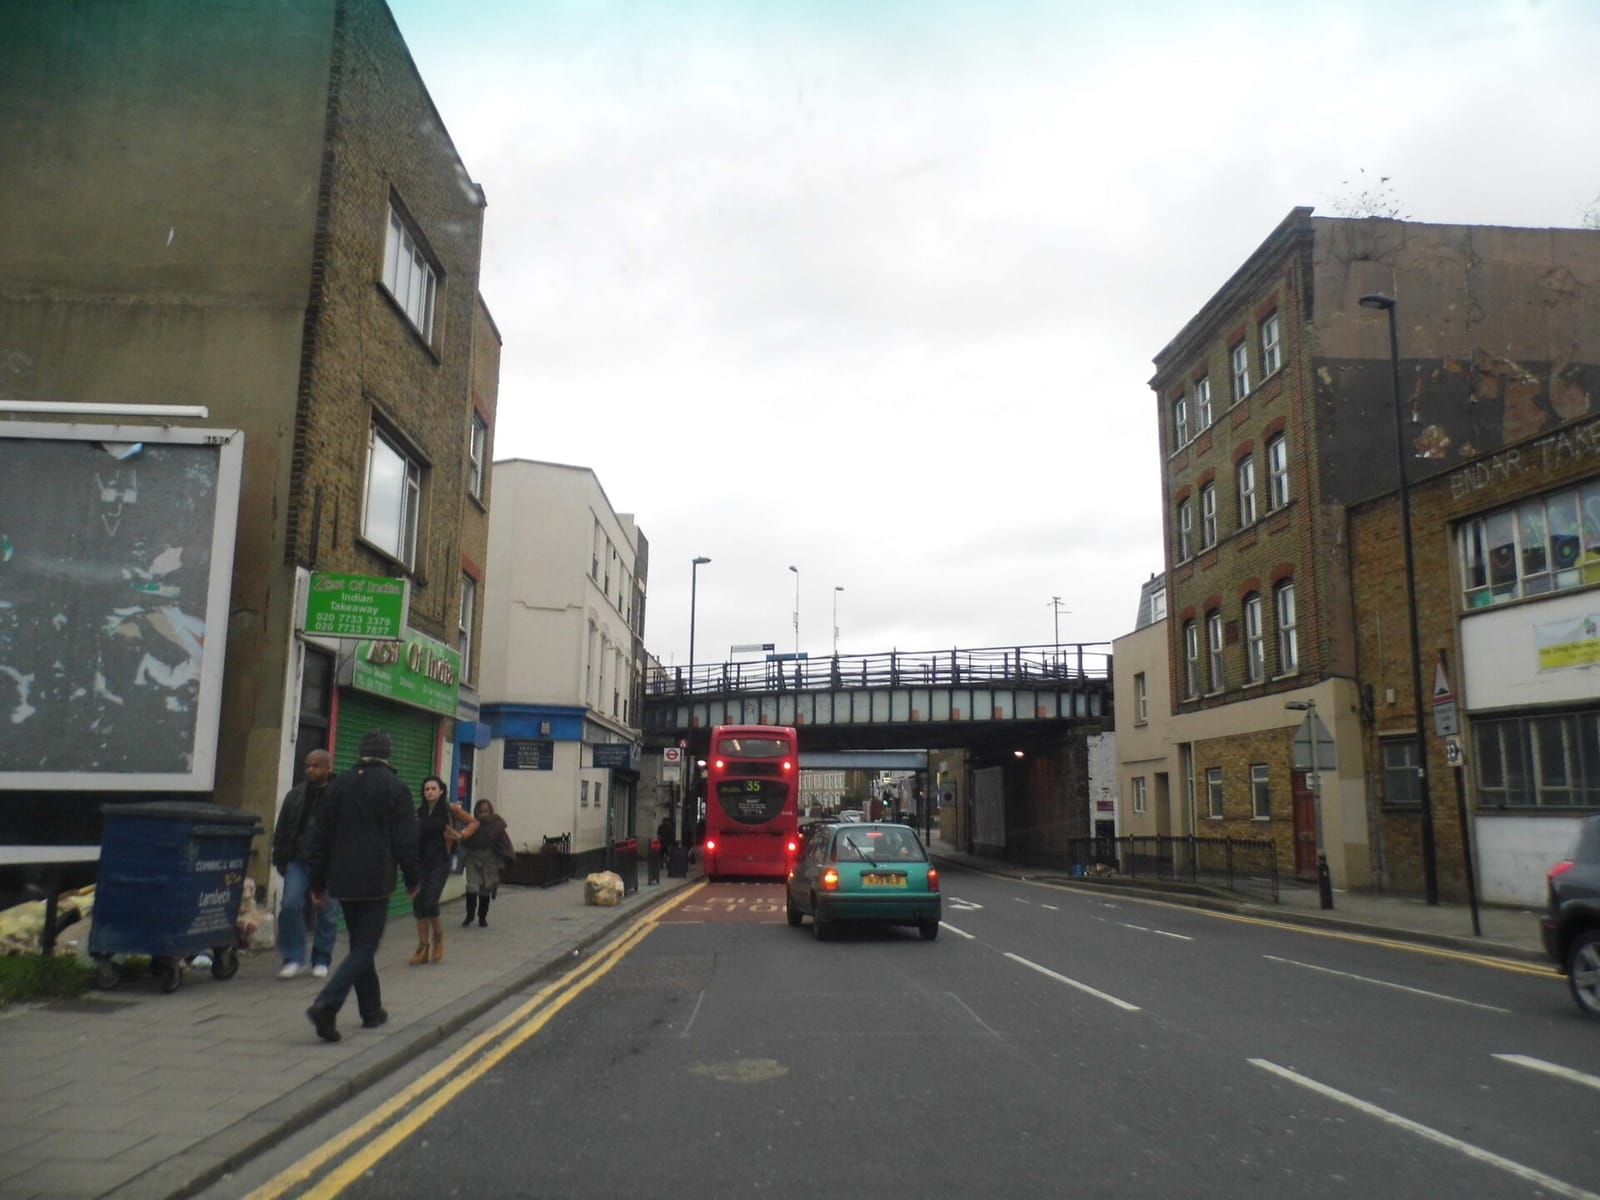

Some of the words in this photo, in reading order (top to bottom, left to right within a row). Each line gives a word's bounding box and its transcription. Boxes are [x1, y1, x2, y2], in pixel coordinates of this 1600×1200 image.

[341, 592, 374, 604] Indian
[330, 601, 379, 617] Takeaway
[316, 612, 336, 623] 020
[338, 613, 363, 625] 7733
[315, 621, 334, 631] 020
[337, 622, 362, 634] 7733
[746, 780, 761, 792] 35
[199, 888, 232, 907] Lambeth
